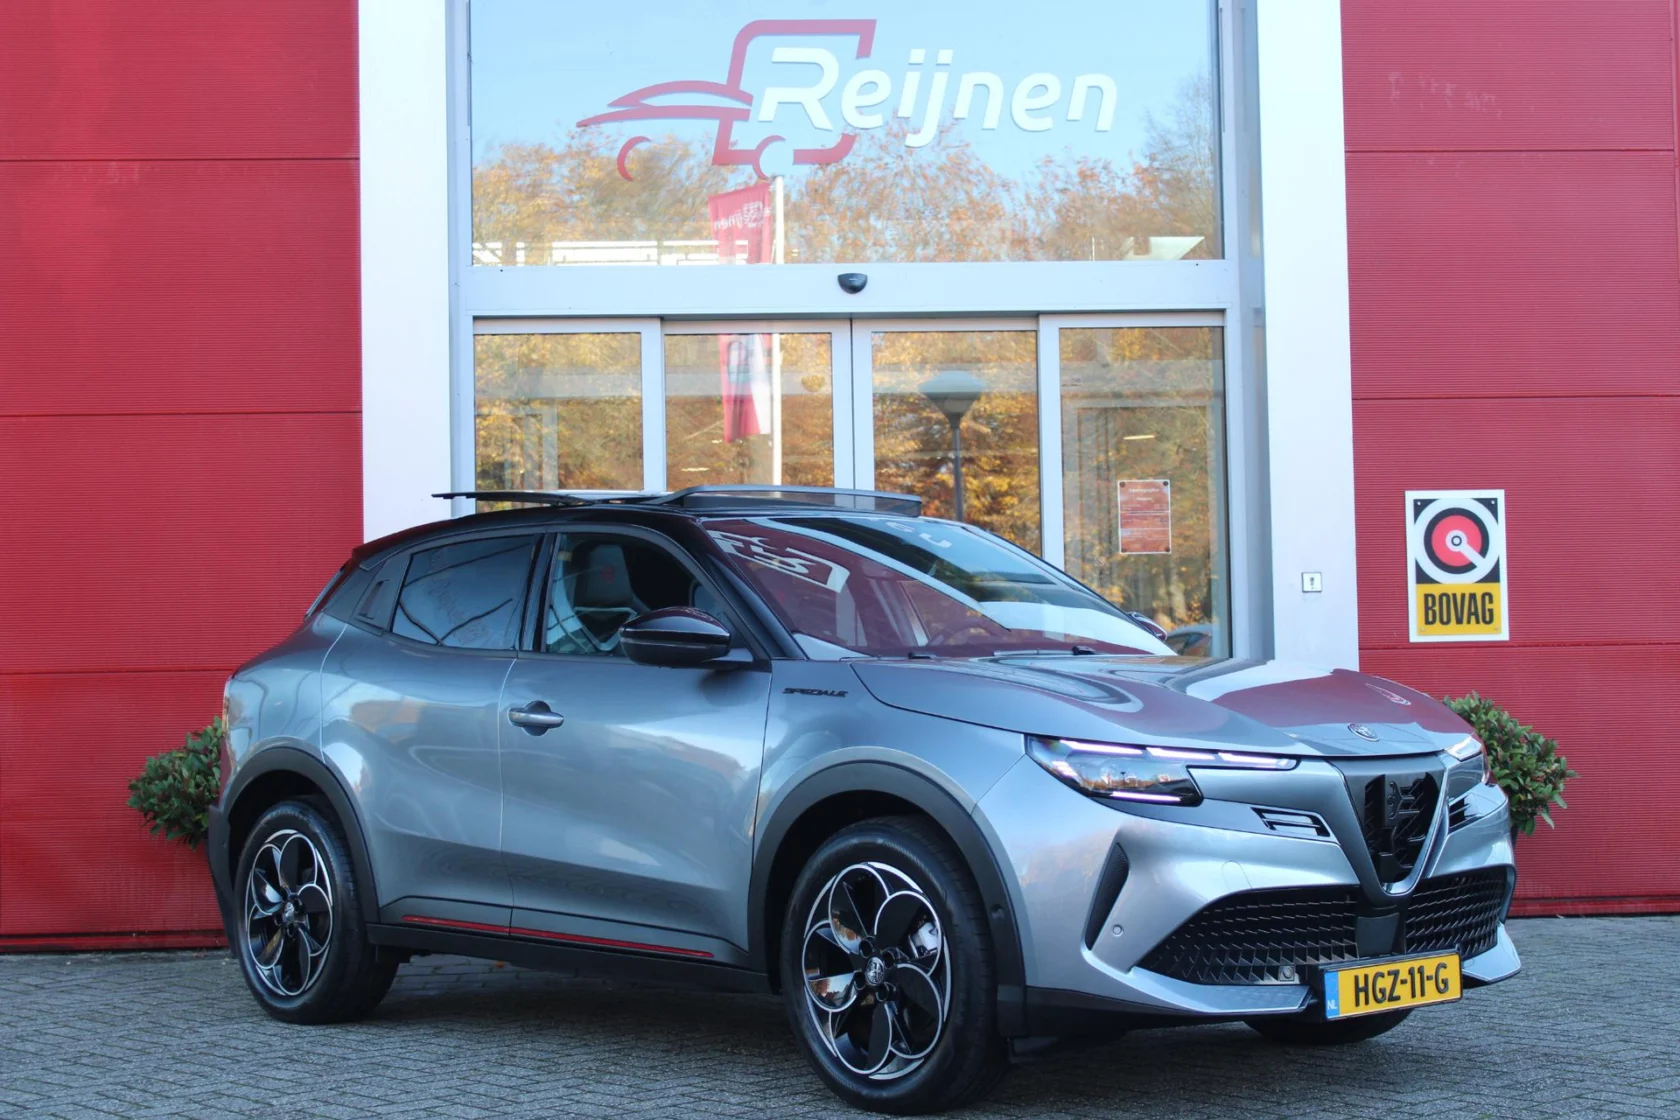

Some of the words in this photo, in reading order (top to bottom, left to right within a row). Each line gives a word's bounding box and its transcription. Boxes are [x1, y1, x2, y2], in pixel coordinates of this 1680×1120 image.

[757, 47, 1118, 148] Reijnen
[1424, 592, 1494, 625] BOVAG
[1354, 962, 1449, 1008] HGZ-11-G
[1327, 1000, 1338, 1010] NL
